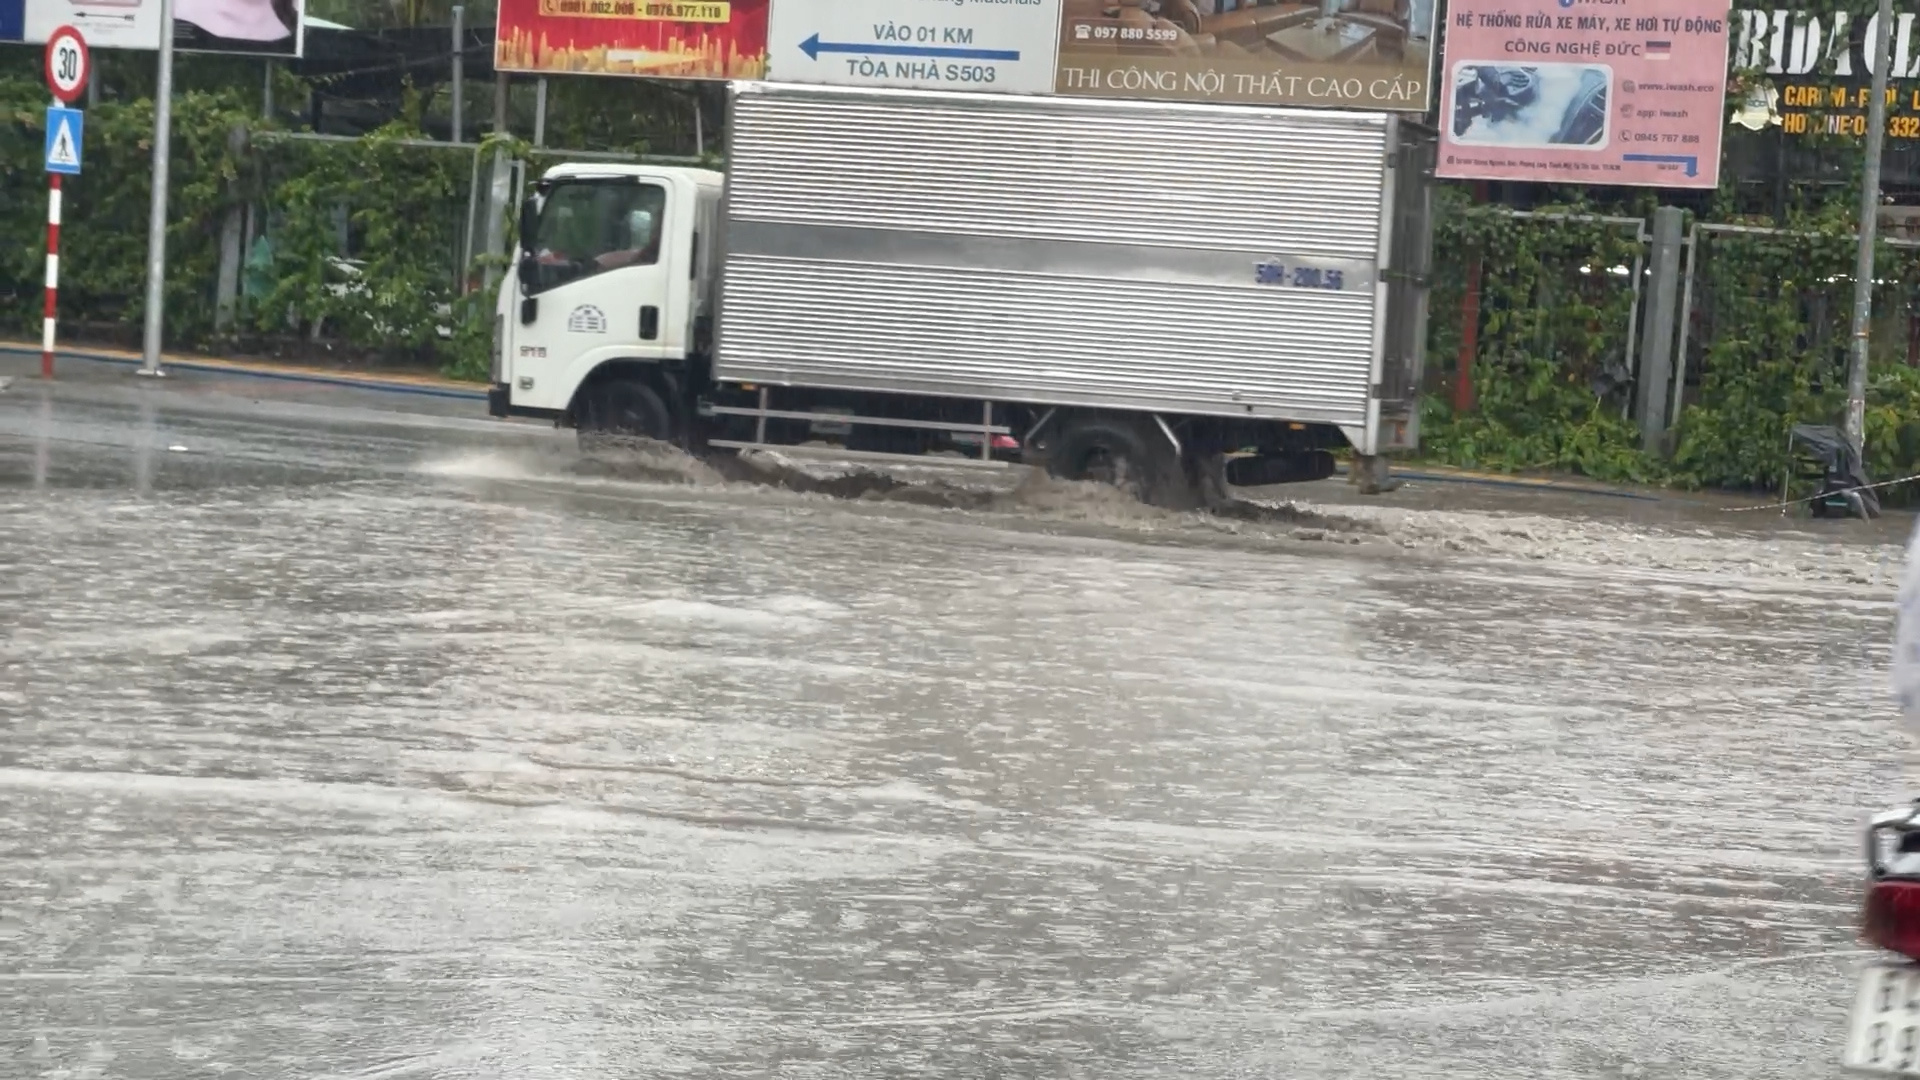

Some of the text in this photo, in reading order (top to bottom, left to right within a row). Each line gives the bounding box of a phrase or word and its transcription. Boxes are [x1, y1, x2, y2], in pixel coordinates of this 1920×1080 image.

[873, 21, 973, 44] VÀO 01 KM
[1478, 10, 1521, 28] THỐNG
[1556, 16, 1573, 30] XE
[1614, 18, 1631, 31] XE
[1685, 16, 1722, 34] ĐỘNG
[1094, 27, 1177, 41] 097 880 5599
[1504, 38, 1641, 58] CÔNG NGHỆ ĐỨC
[58, 47, 78, 81] 30
[846, 56, 996, 83] TÒA NHÀ S503
[1062, 65, 1421, 101] THI CÔNG NỘI THẤT CAO CẤP
[1784, 85, 1846, 107] CARM
